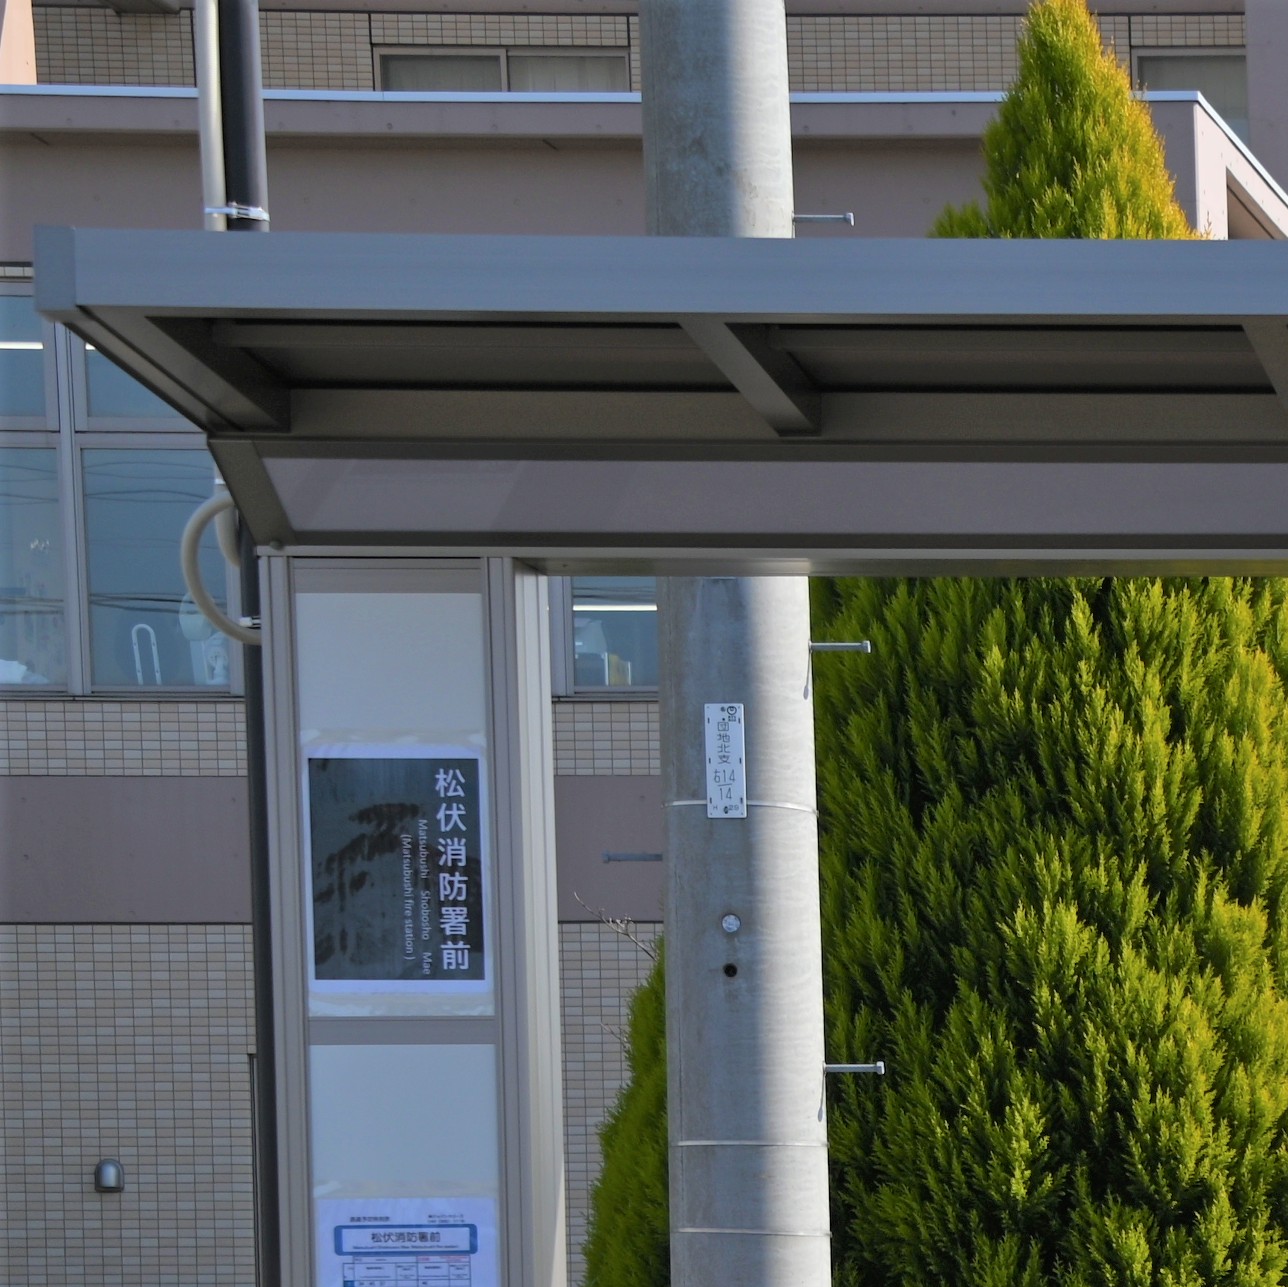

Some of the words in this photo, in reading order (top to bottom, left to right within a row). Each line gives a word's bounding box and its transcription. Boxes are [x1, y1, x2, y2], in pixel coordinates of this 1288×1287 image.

[719, 787, 732, 800] 14
[400, 834, 413, 897] (Matsubushi
[418, 819, 430, 879] Matsubushi
[434, 768, 471, 970] 松伏消防署前
[404, 899, 414, 916] fire
[420, 890, 432, 940] Shobosho
[422, 952, 432, 975] Mae
[371, 1231, 441, 1243] 松伏消防署前
